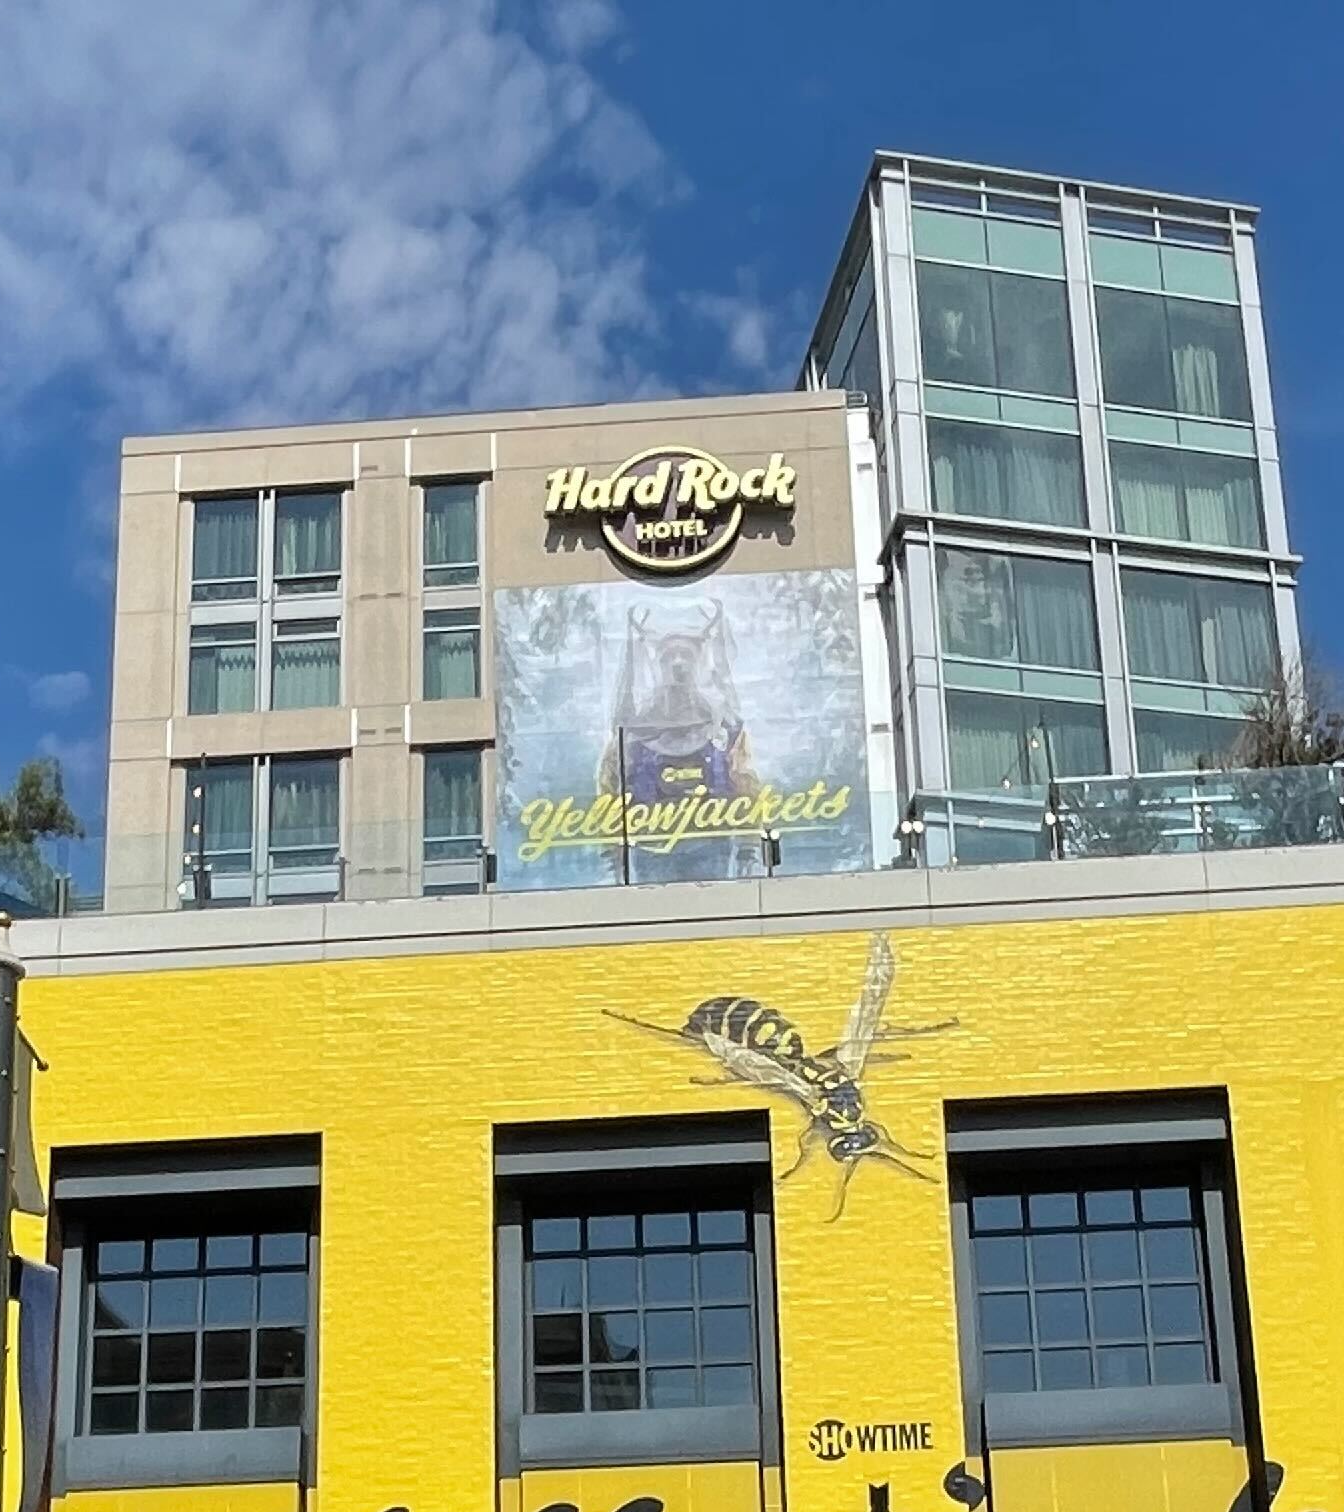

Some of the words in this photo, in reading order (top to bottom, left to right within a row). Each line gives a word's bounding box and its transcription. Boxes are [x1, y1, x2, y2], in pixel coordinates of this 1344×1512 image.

[545, 460, 672, 514] Hard
[677, 453, 796, 512] Rock
[636, 519, 708, 541] HOTEL
[519, 781, 851, 863] Yellowjackets
[808, 1418, 934, 1461] SHOWTIME
